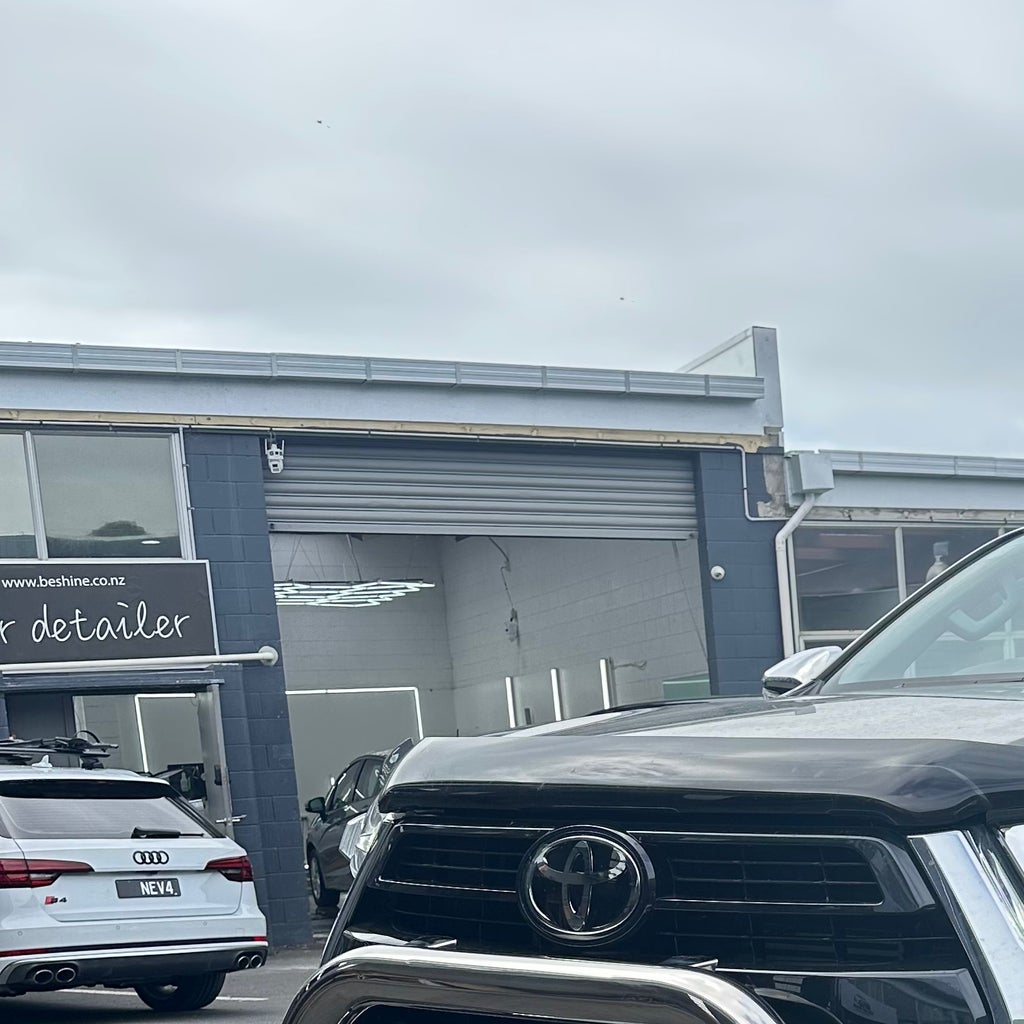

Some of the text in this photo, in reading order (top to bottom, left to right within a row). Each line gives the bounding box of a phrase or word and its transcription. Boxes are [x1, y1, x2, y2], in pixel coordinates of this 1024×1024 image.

[1, 575, 126, 588] www.beshine.co.nz
[31, 601, 190, 643] detailer
[140, 880, 174, 896] NEV4
